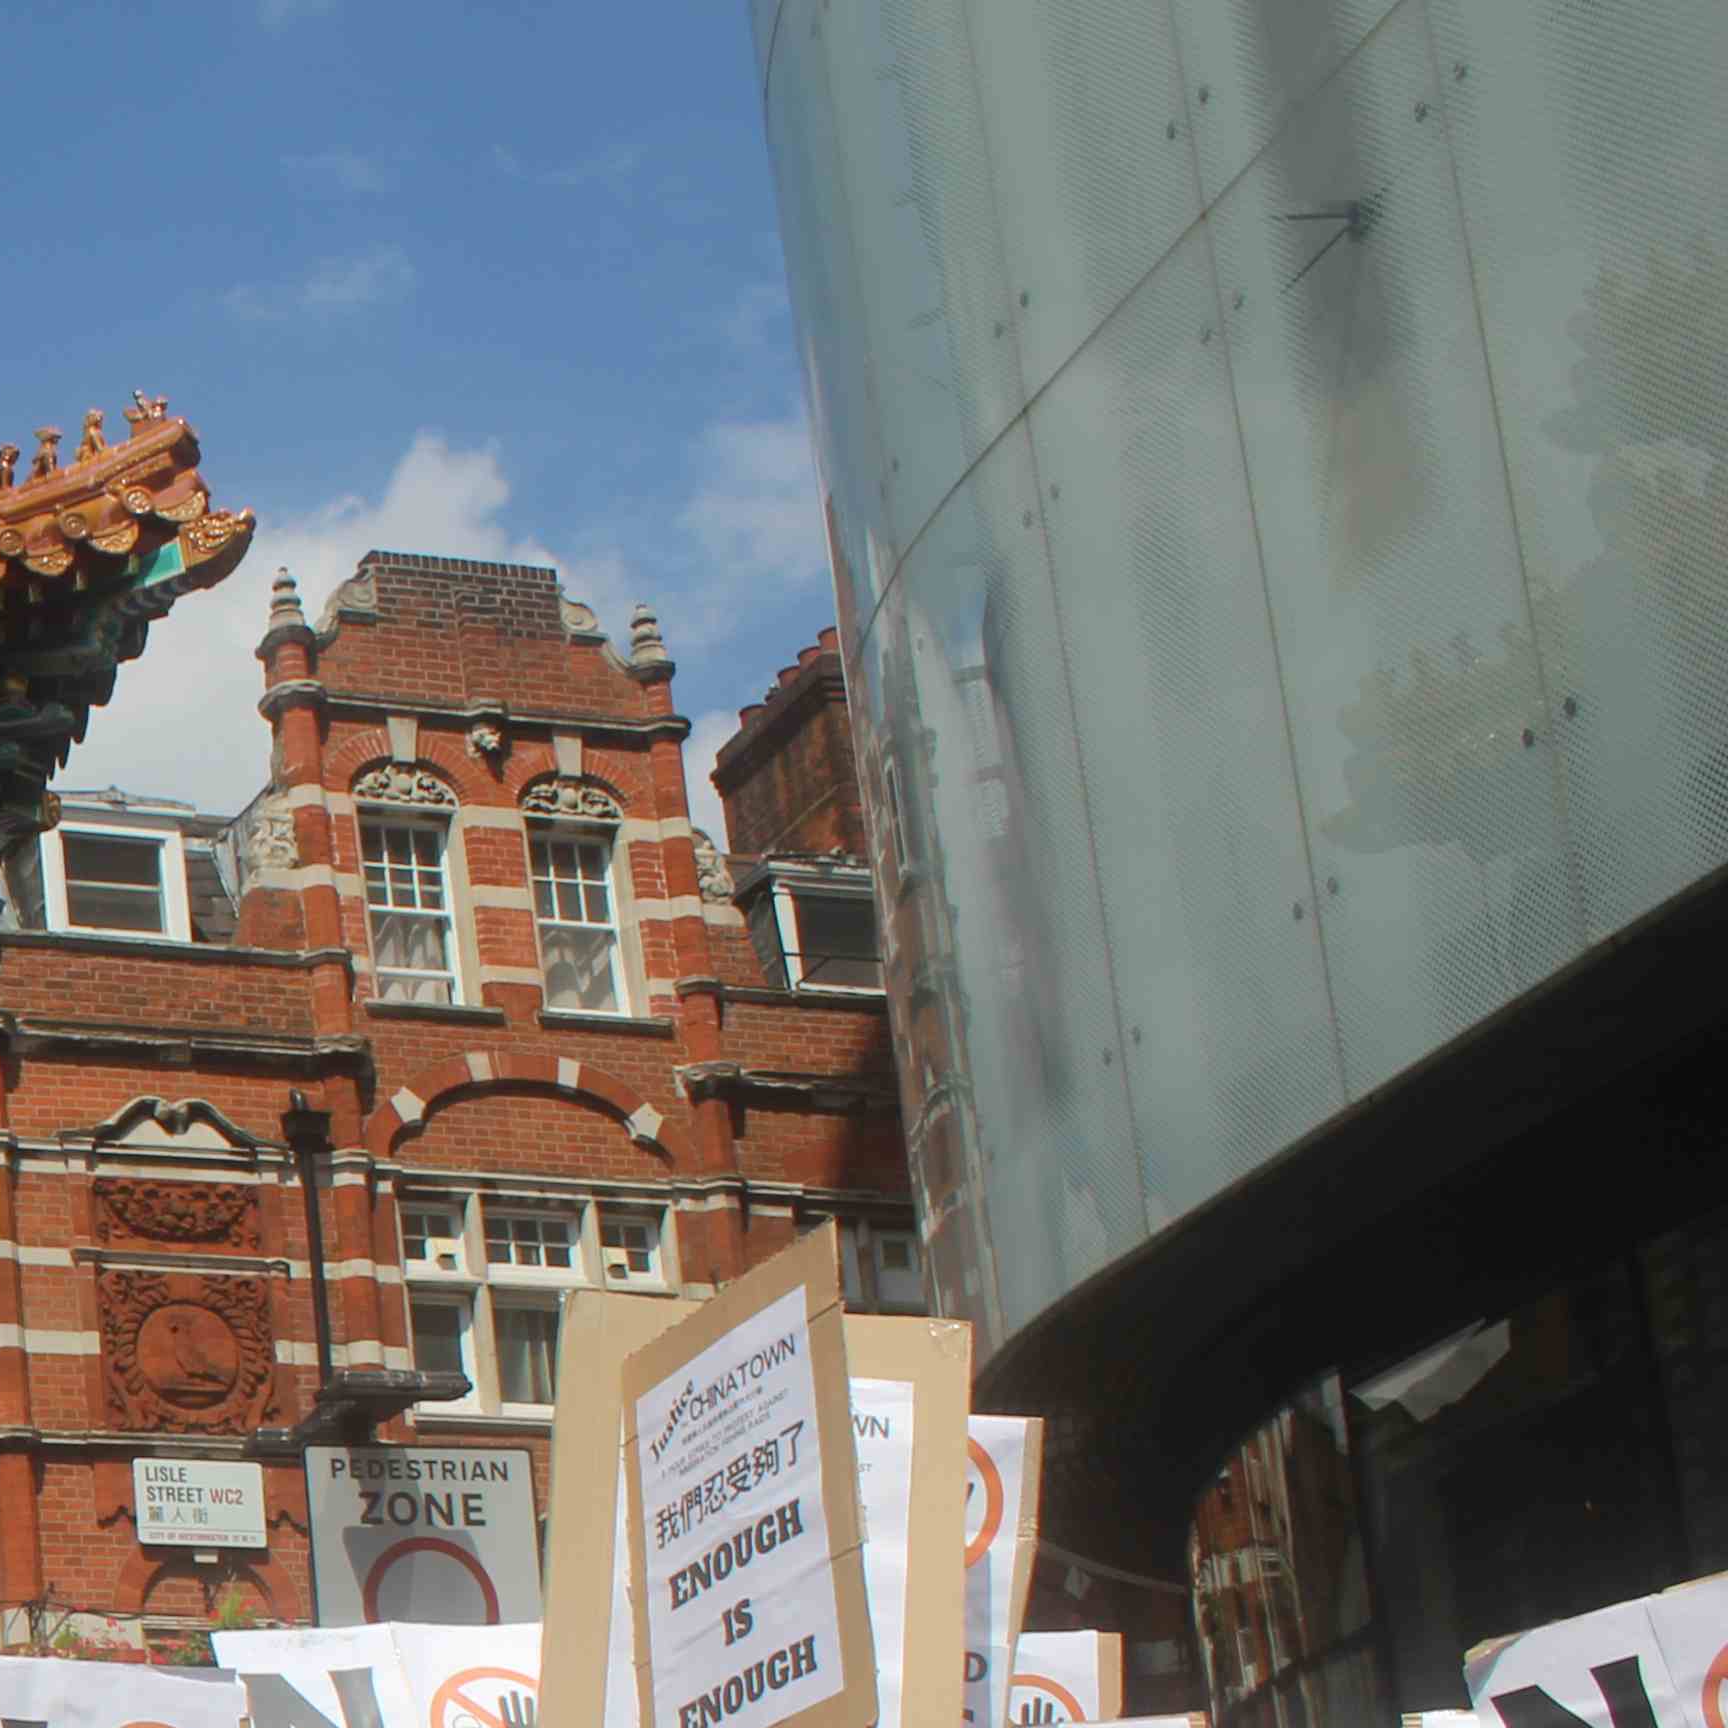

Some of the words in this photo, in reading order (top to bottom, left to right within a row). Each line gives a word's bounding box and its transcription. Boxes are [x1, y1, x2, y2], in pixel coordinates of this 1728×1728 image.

[690, 1333, 795, 1422] CHINATOWN
[145, 1466, 187, 1483] LISLE
[330, 1458, 509, 1482] PEDESTRIAN
[655, 1419, 804, 1550] 我們忍受夠了
[146, 1486, 204, 1503] STREET
[209, 1488, 243, 1504] WC2
[360, 1491, 487, 1527] ZONE
[667, 1499, 804, 1611] ENOUGH
[721, 1598, 753, 1647] IS
